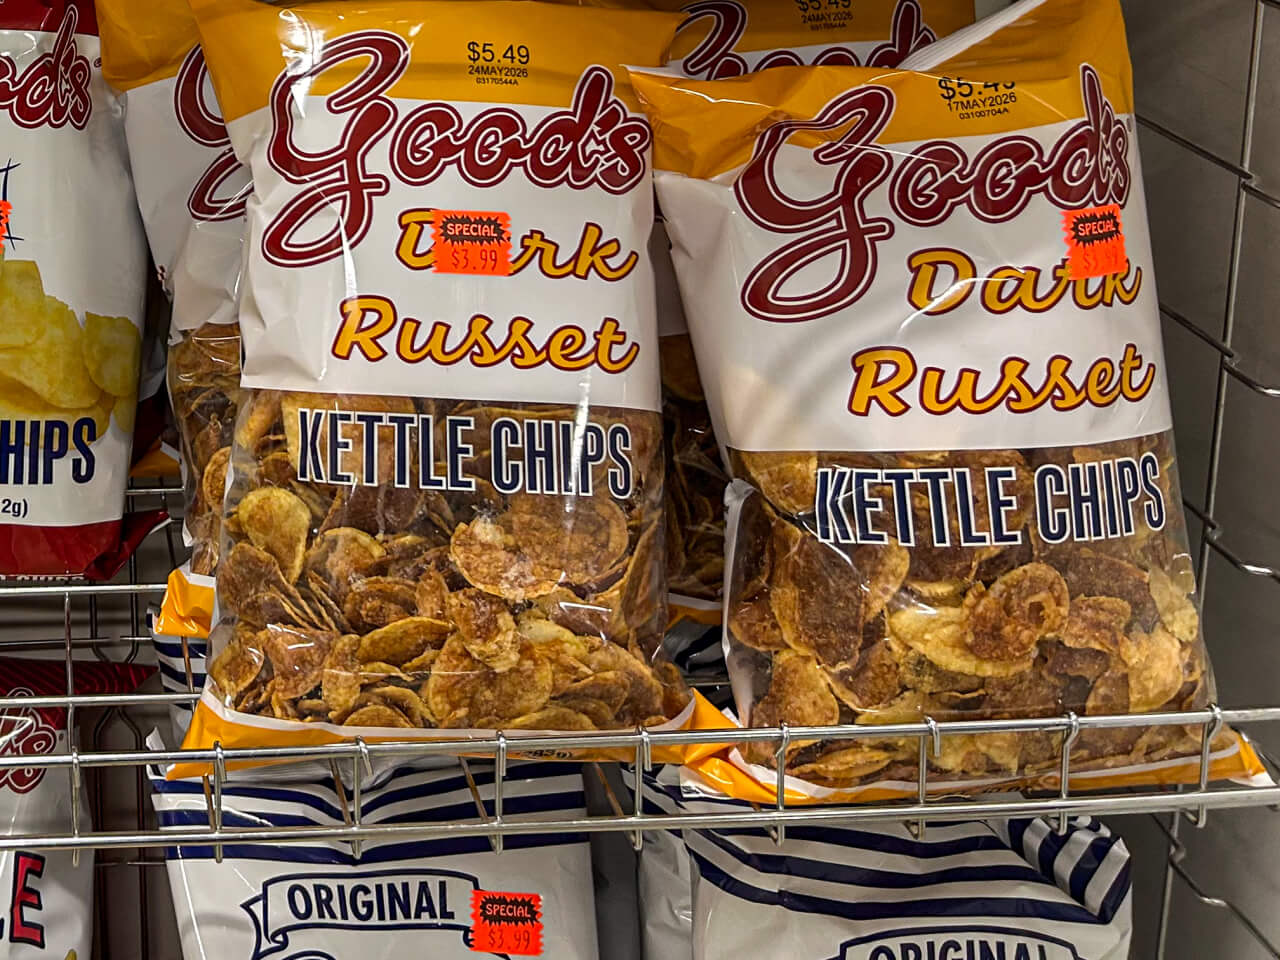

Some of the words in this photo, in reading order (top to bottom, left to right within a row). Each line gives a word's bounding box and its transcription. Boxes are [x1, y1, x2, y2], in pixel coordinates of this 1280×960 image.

[467, 41, 530, 65] $5.49
[468, 64, 529, 78] 24MAY2026
[946, 92, 1017, 112] 17MAY2026
[445, 222, 499, 238] SPECIAL
[1077, 218, 1116, 237] SPECIAL
[395, 207, 639, 283] Drk
[450, 248, 499, 272] $3.99
[331, 295, 640, 374] Russet
[847, 344, 1157, 418] Russet
[296, 407, 474, 493] KETTLE
[490, 416, 633, 500] CHIPS
[816, 466, 1022, 548] KETTLE
[1034, 452, 1166, 545] CHIPS
[285, 880, 456, 922] ORIGINAL
[485, 903, 532, 918] SPECIAL
[487, 927, 531, 950] $3.99
